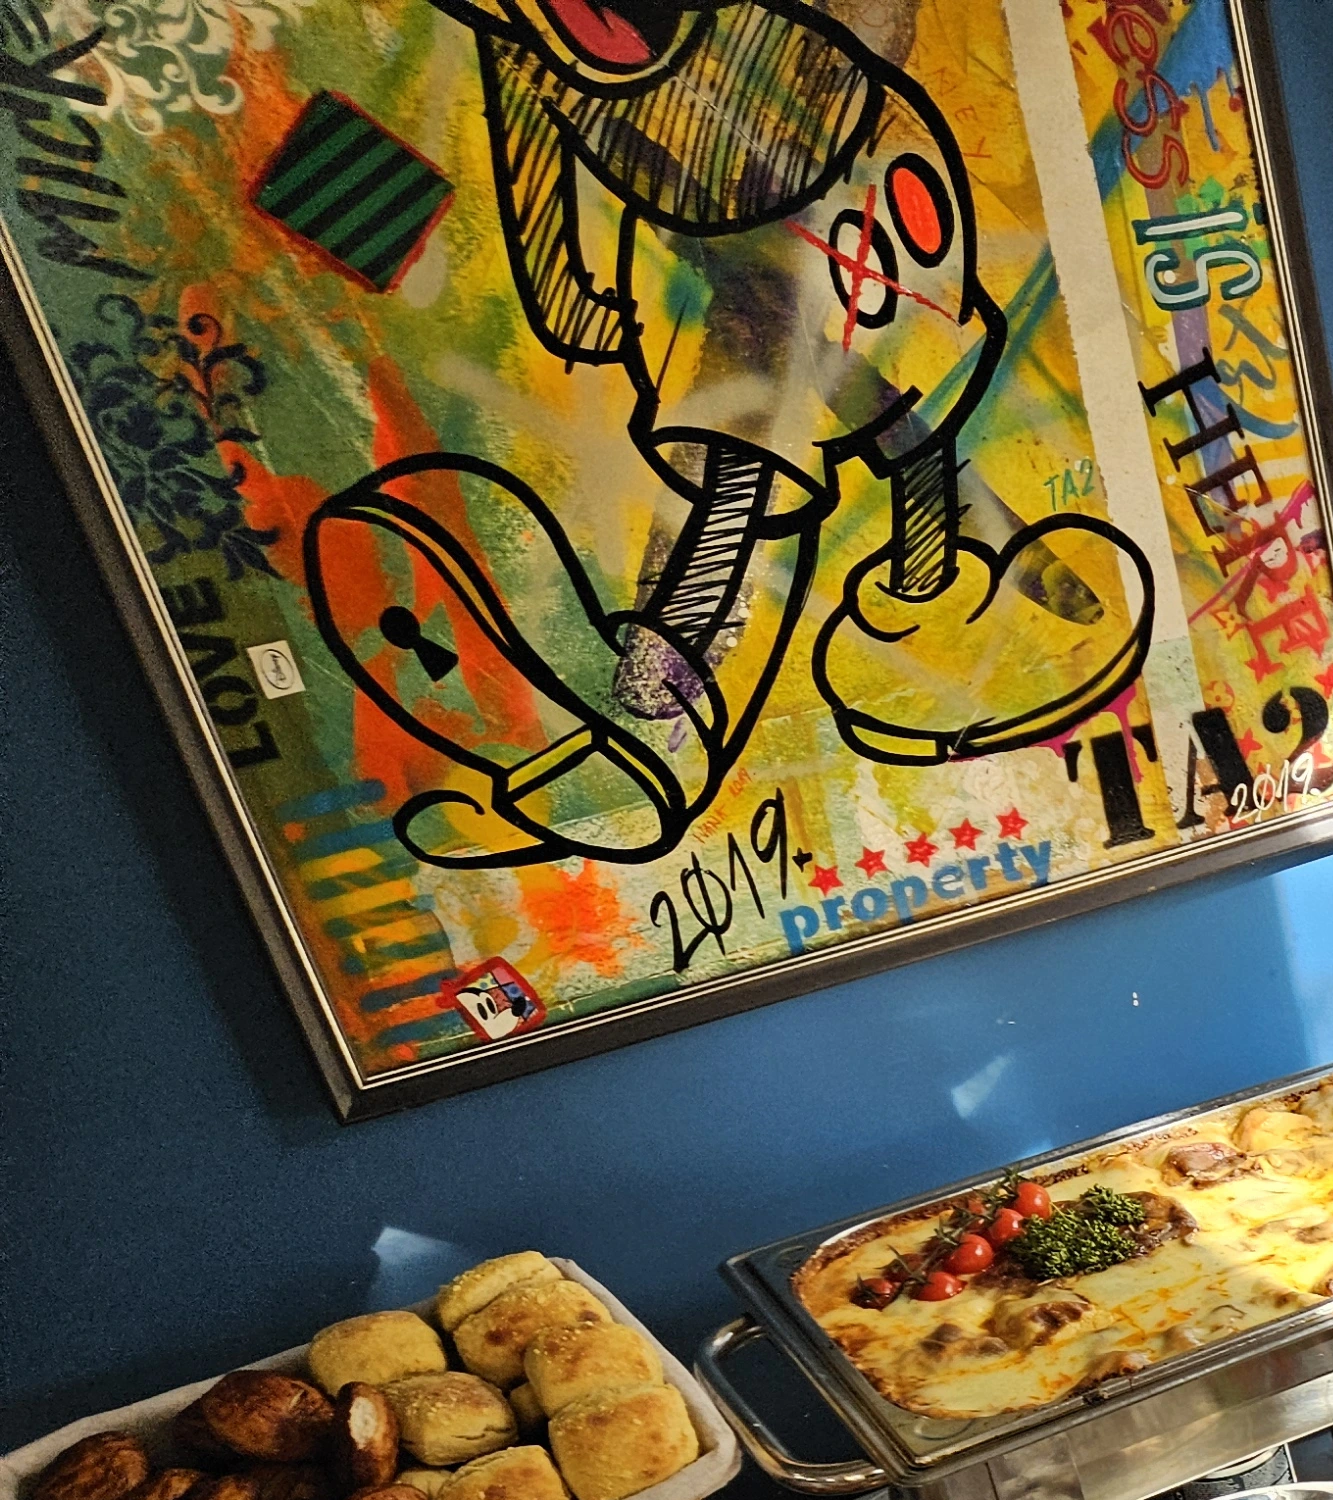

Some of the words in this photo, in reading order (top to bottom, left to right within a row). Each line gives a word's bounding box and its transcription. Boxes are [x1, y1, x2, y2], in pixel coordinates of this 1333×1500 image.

[1043, 458, 1095, 511] TA2
[161, 577, 281, 768] LOVE
[779, 840, 1052, 955] property
